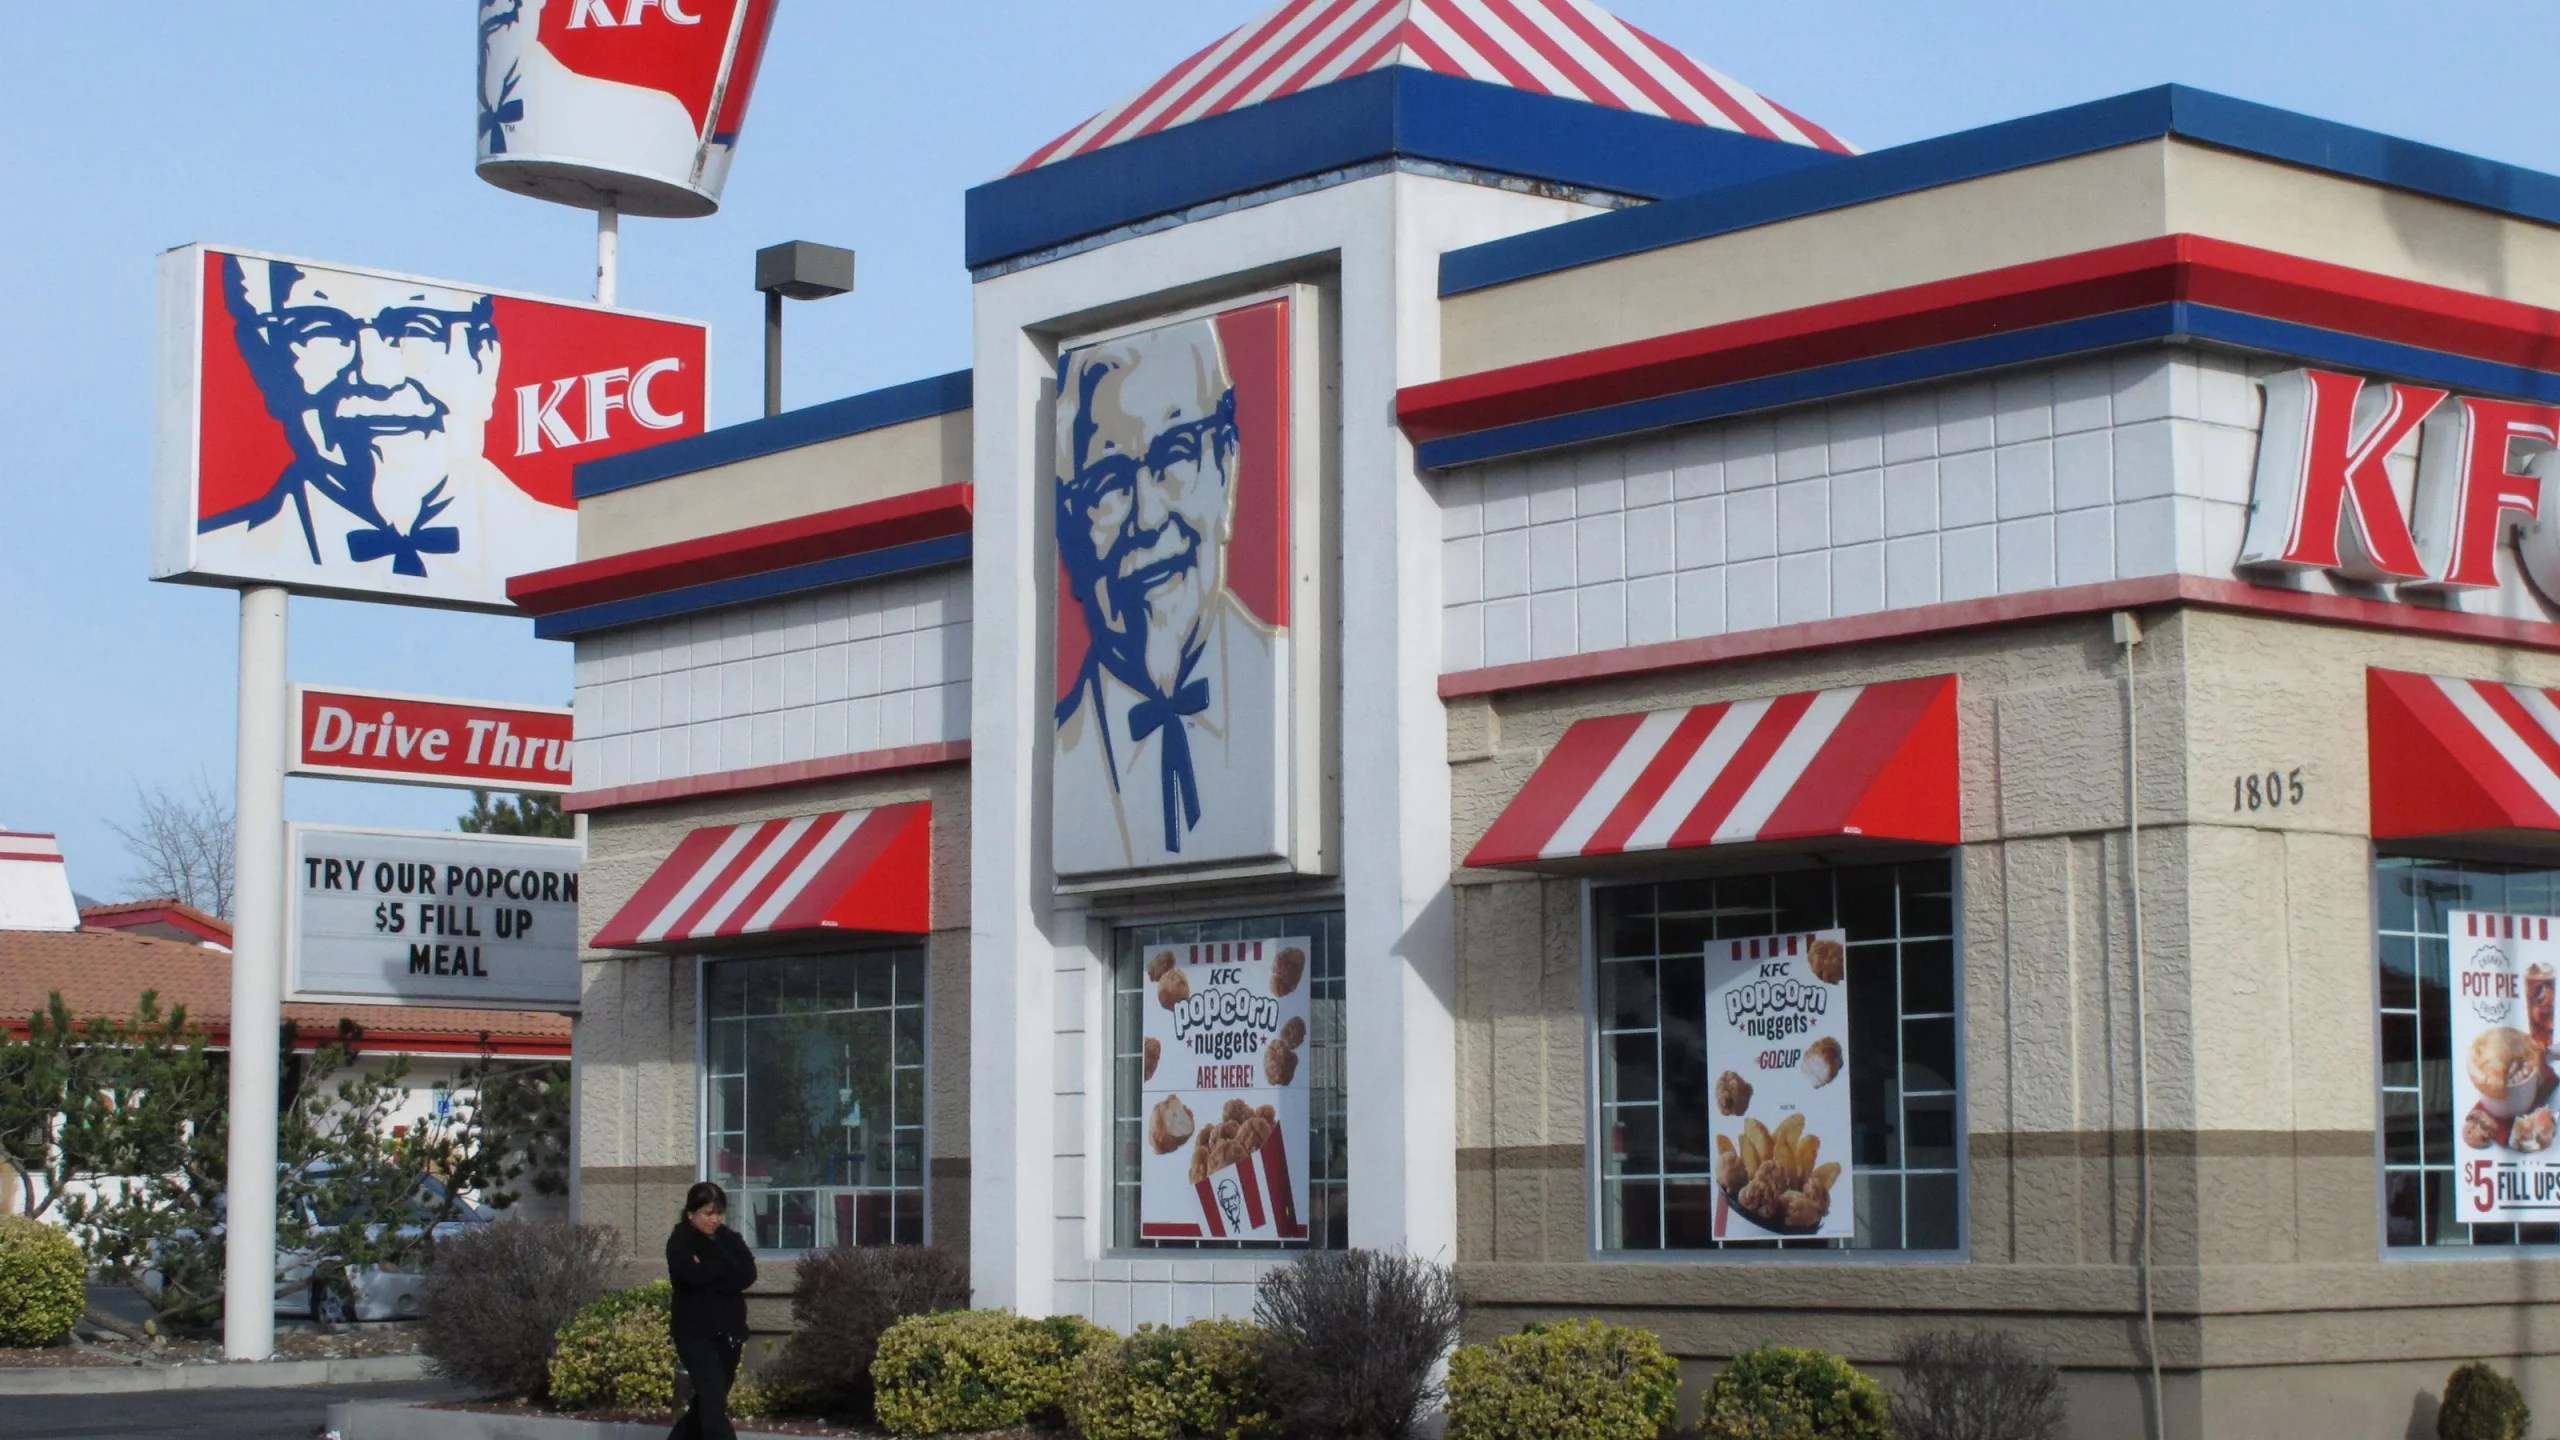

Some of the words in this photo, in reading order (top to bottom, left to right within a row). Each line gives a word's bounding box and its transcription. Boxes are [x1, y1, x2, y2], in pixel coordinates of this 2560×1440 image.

[514, 357, 684, 457] KFC
[310, 706, 450, 762] Drive
[464, 719, 573, 772] Thru
[2234, 766, 2304, 812] 1805
[305, 857, 365, 891] TRY
[375, 862, 436, 895] OUR
[447, 865, 579, 903] POPCORN
[376, 902, 405, 933] $5
[419, 904, 481, 937] FILL
[495, 908, 533, 939] UP
[409, 943, 488, 977] MEAL
[1209, 968, 1241, 985] KFC
[1759, 962, 1790, 978] KFC
[1725, 979, 1827, 1025] popcorn
[2462, 971, 2490, 997] POT
[2495, 972, 2519, 998] PIE
[1173, 988, 1279, 1040] popcorn
[1747, 1013, 1808, 1040] nuggets
[1195, 1028, 1258, 1060] nuggets
[1196, 1065, 1218, 1089] ARE
[1221, 1064, 1254, 1088] HERE!
[2465, 1160, 2494, 1212] $5
[2498, 1171, 2530, 1201] FILL
